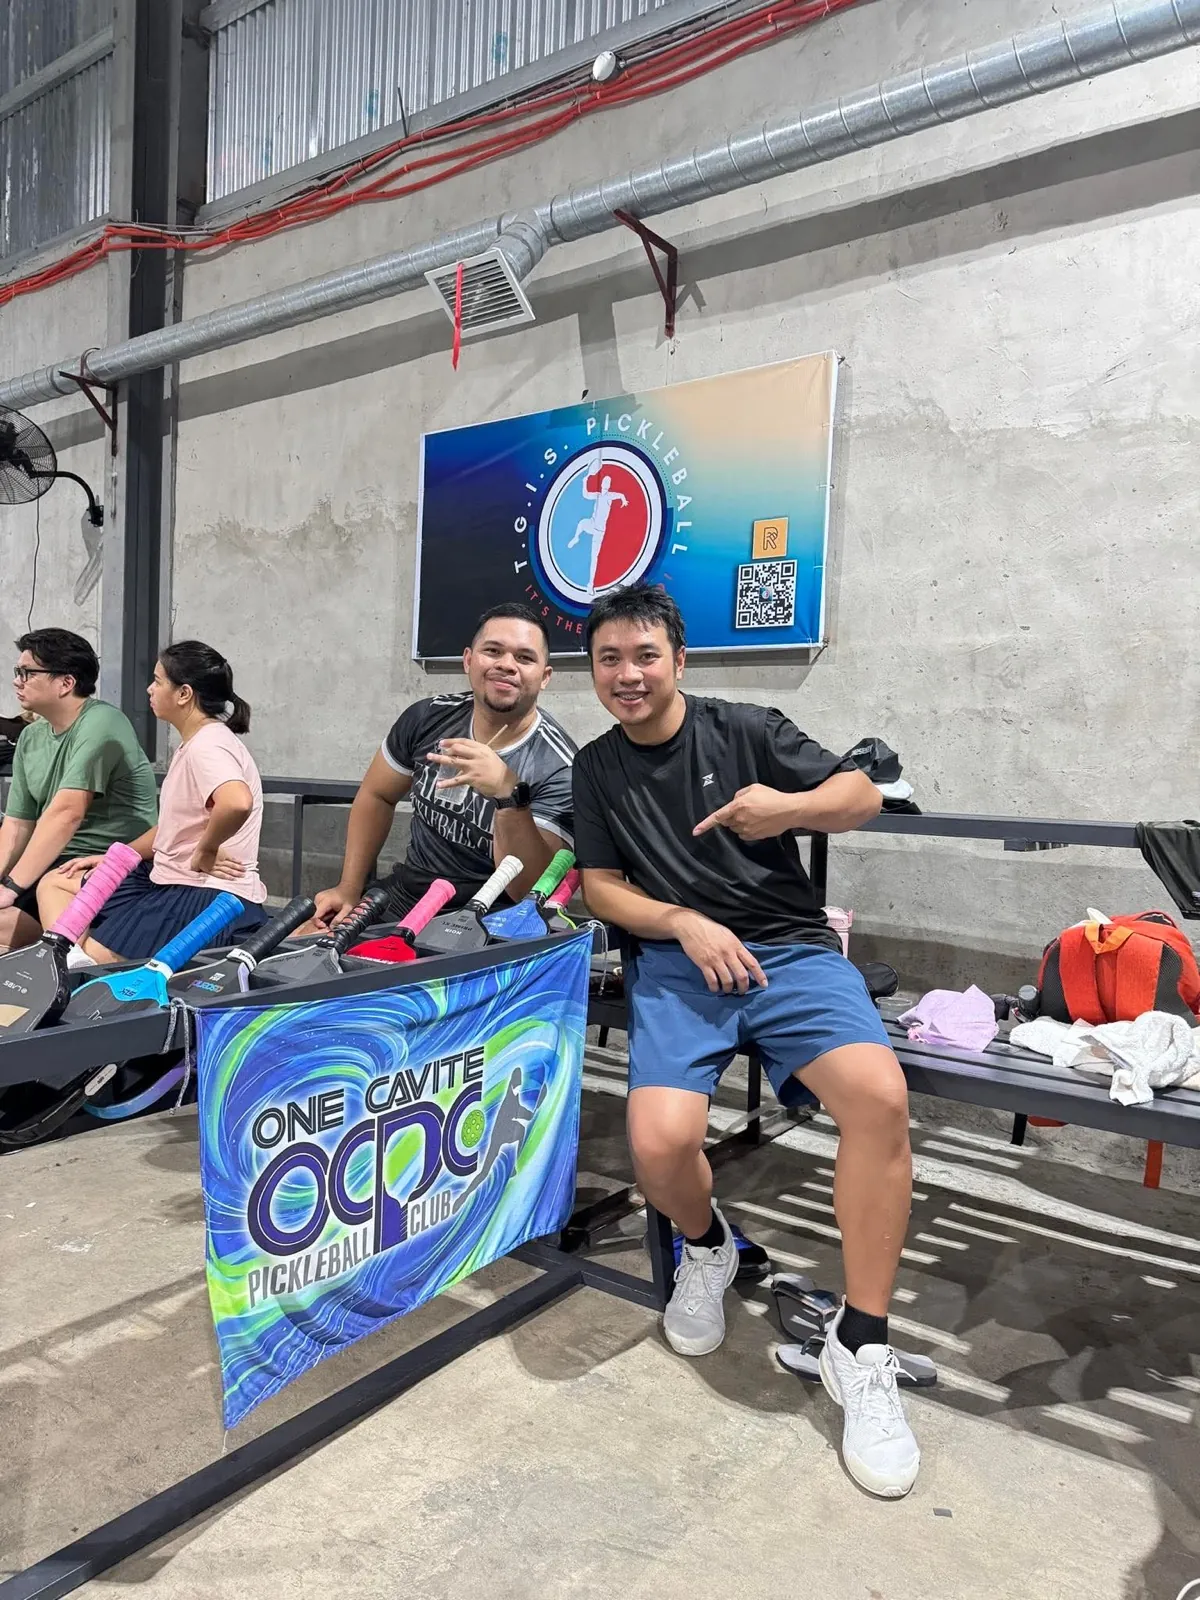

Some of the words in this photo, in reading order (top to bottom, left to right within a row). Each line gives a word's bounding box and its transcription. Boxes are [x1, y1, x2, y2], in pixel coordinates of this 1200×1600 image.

[586, 413, 692, 555] PICKLEBALL
[556, 615, 582, 634] THE
[252, 1088, 344, 1149] ONE
[365, 1046, 485, 1114] CAVITE
[248, 1227, 372, 1309] PICKLEBALL
[410, 1189, 451, 1237] CLUB
